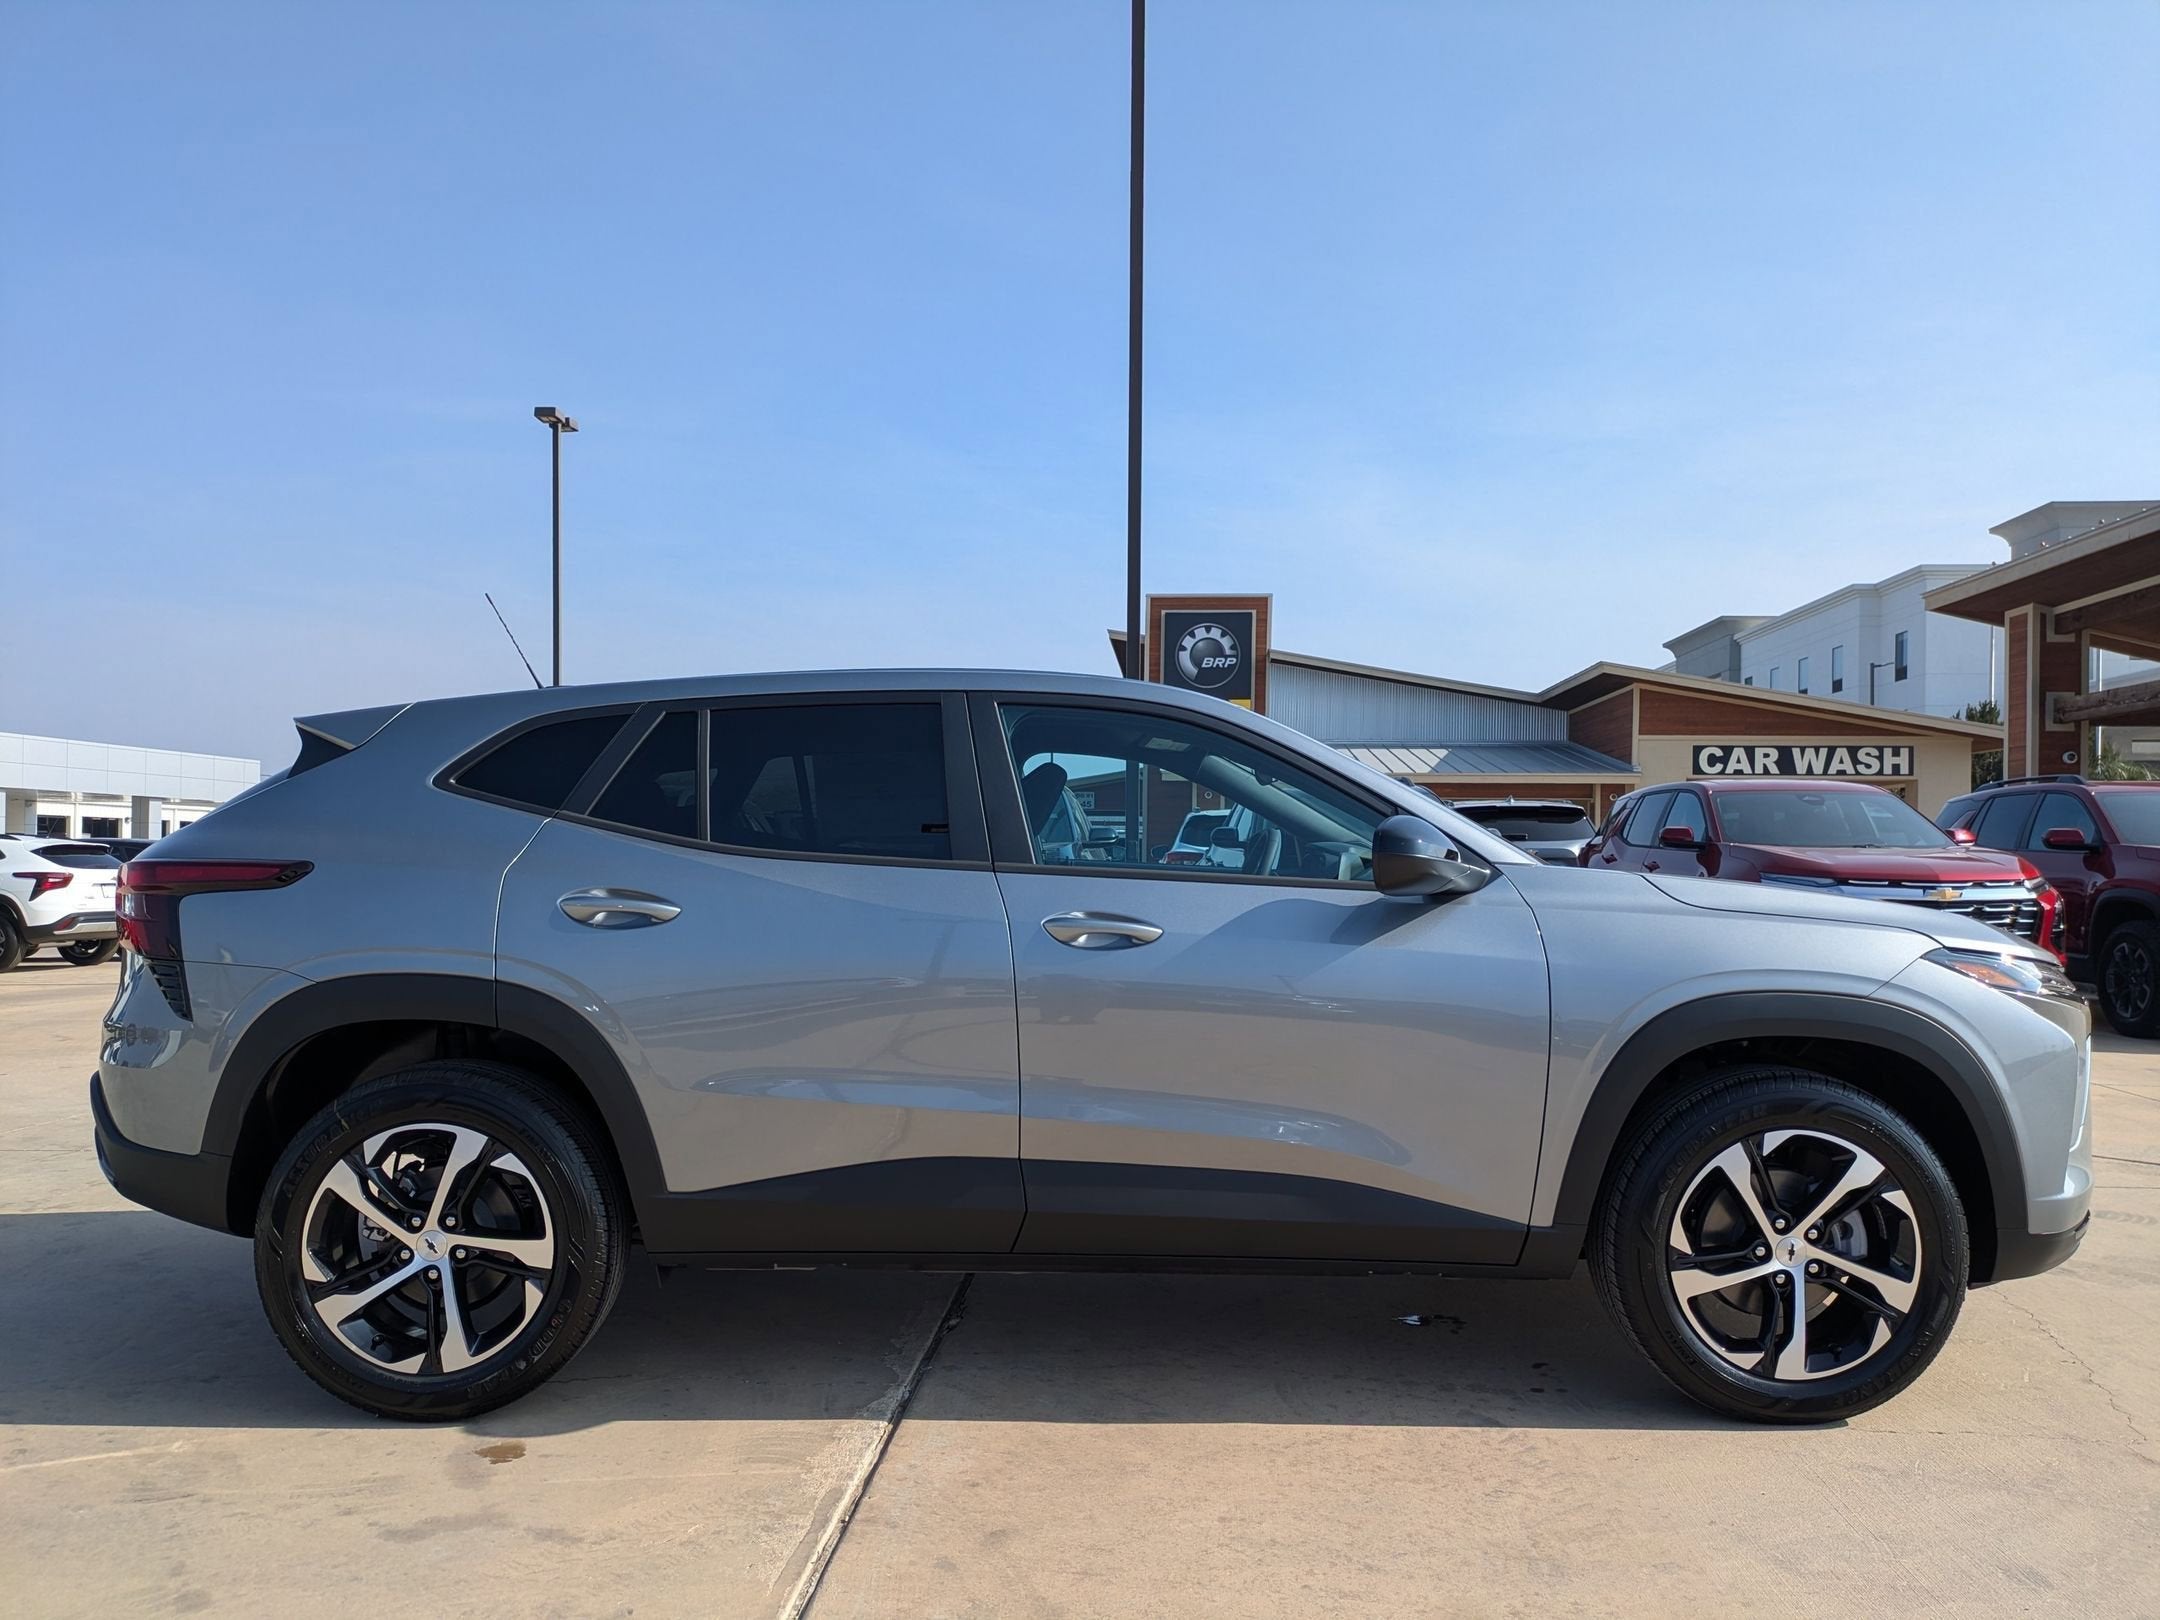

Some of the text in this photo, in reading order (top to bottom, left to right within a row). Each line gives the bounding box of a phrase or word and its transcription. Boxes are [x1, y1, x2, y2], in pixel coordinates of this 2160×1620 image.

[1201, 657, 1237, 668] BRP
[1698, 746, 1910, 775] CAR WASH
